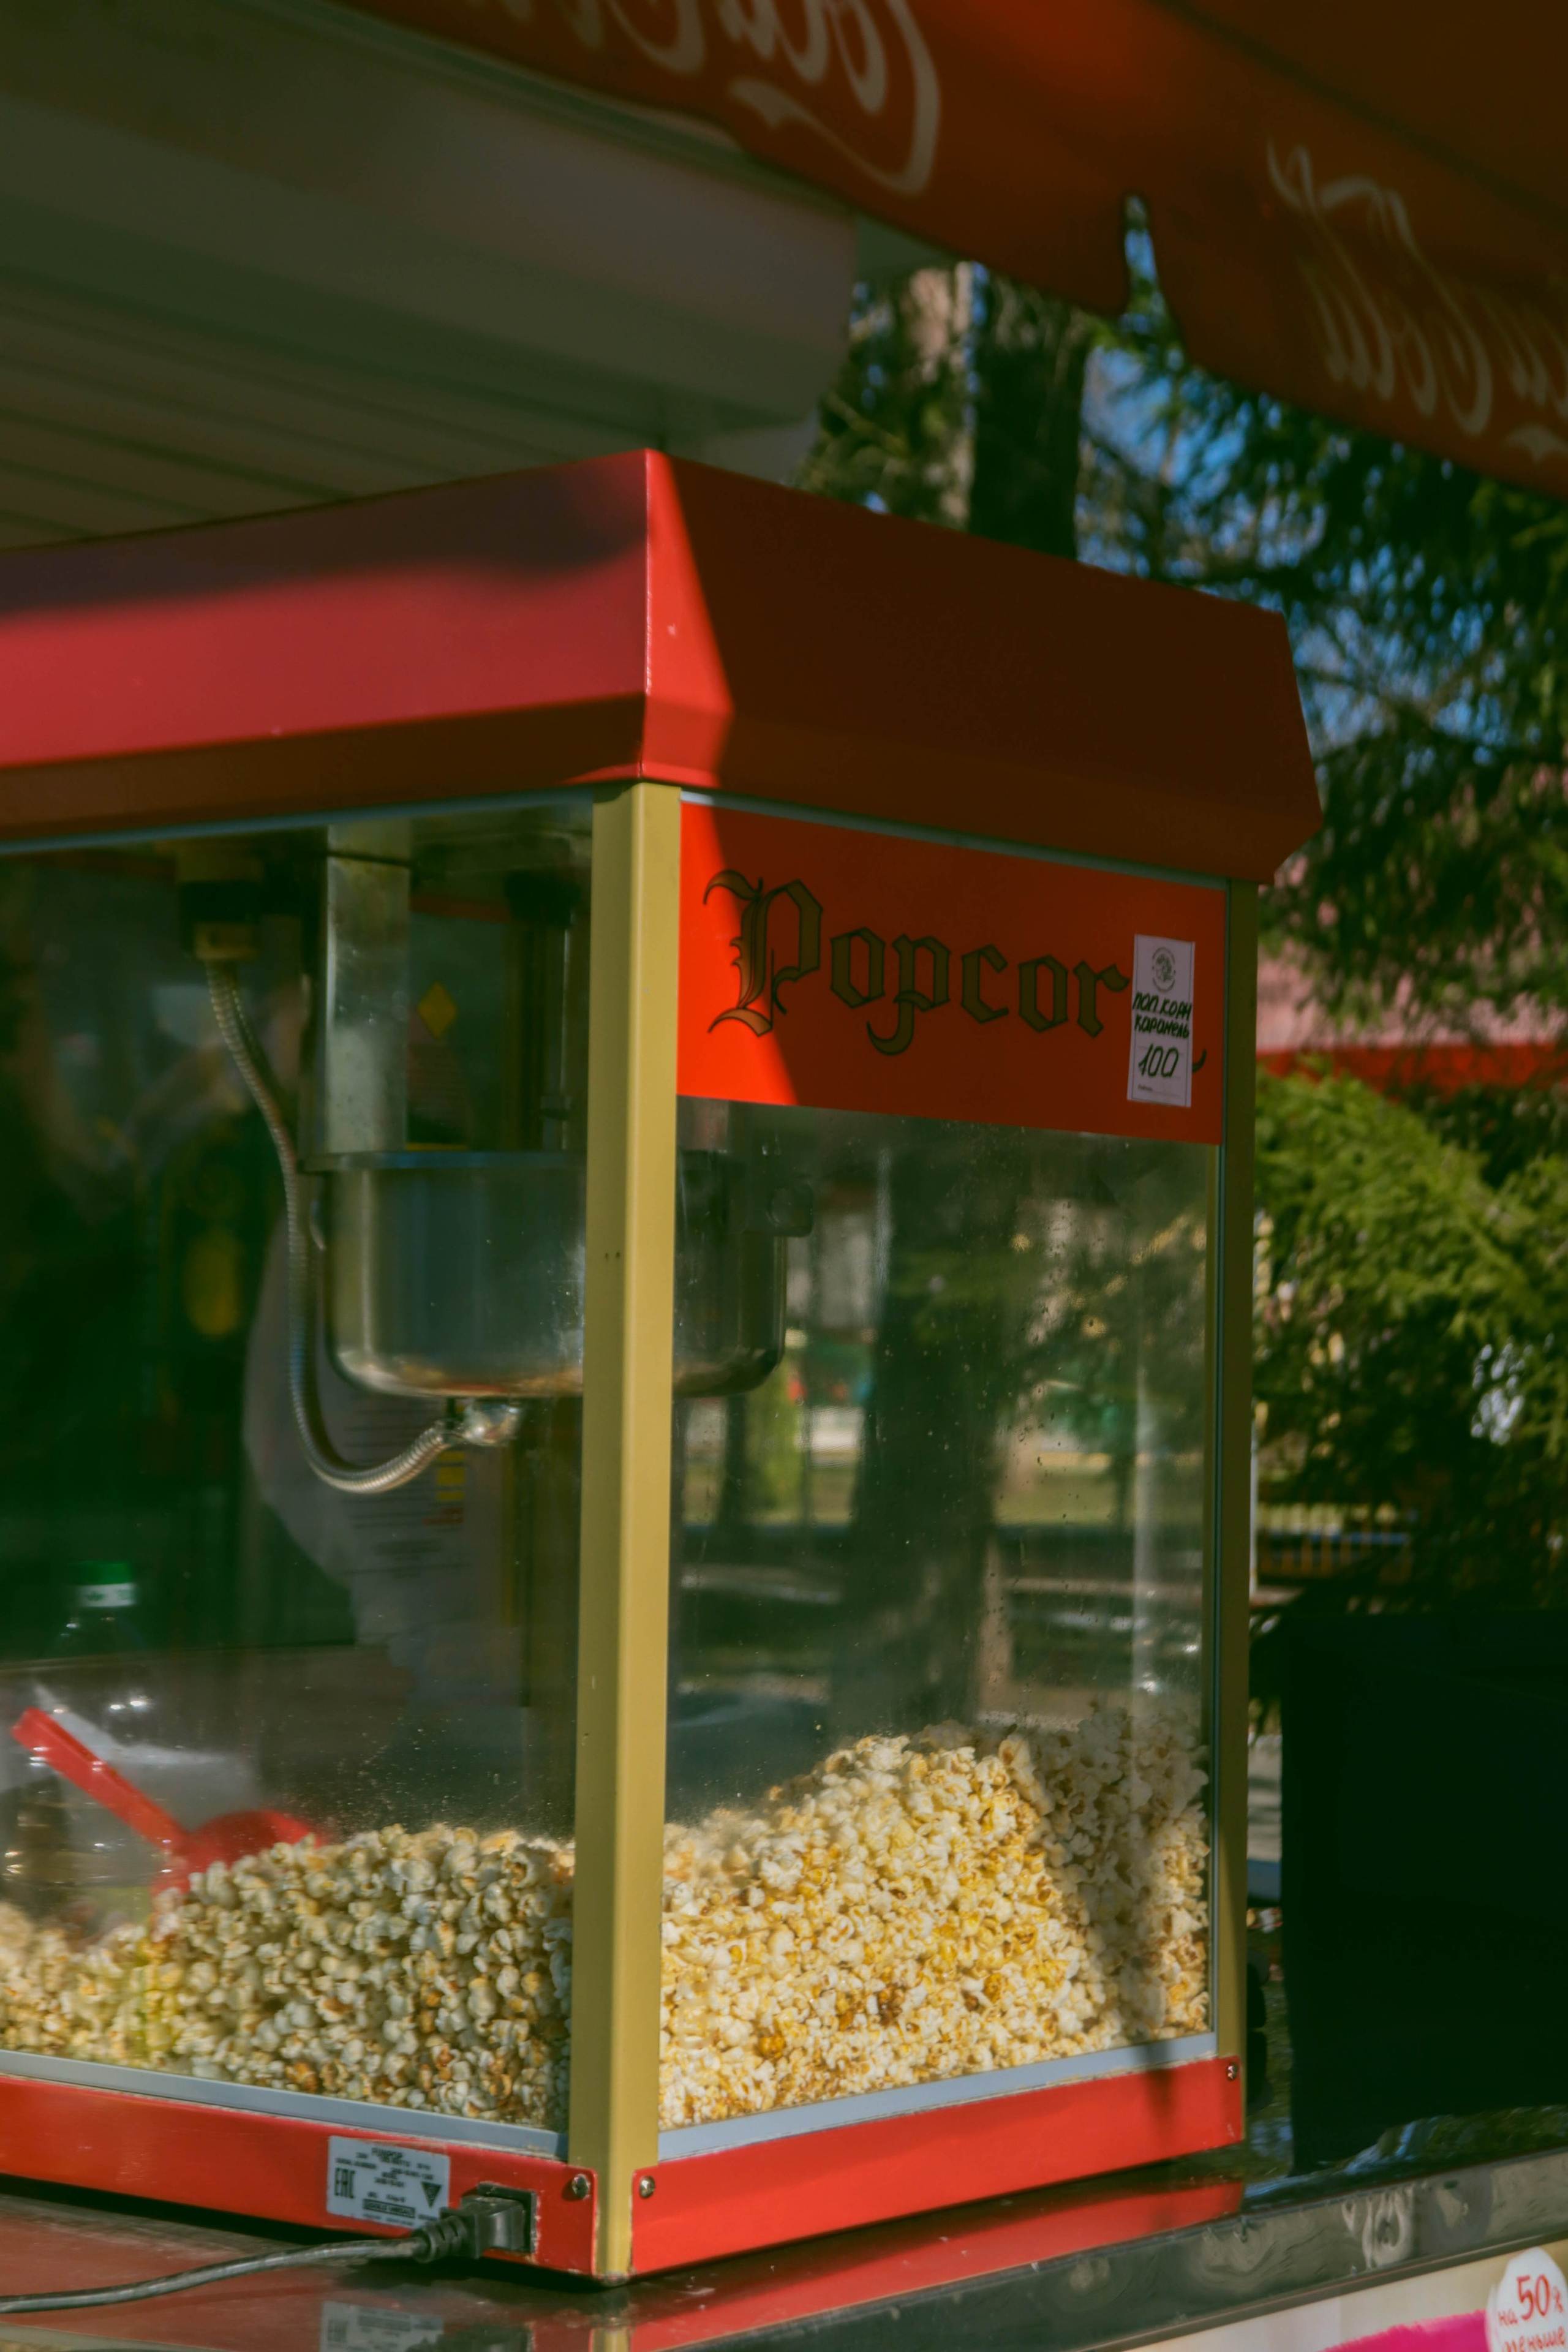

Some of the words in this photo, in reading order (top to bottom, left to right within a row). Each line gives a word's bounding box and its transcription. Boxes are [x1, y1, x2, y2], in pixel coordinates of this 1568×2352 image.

[703, 870, 1207, 1074] Popcor
[1138, 1042, 1179, 1077] 100
[1516, 2274, 1564, 2320] 50%
